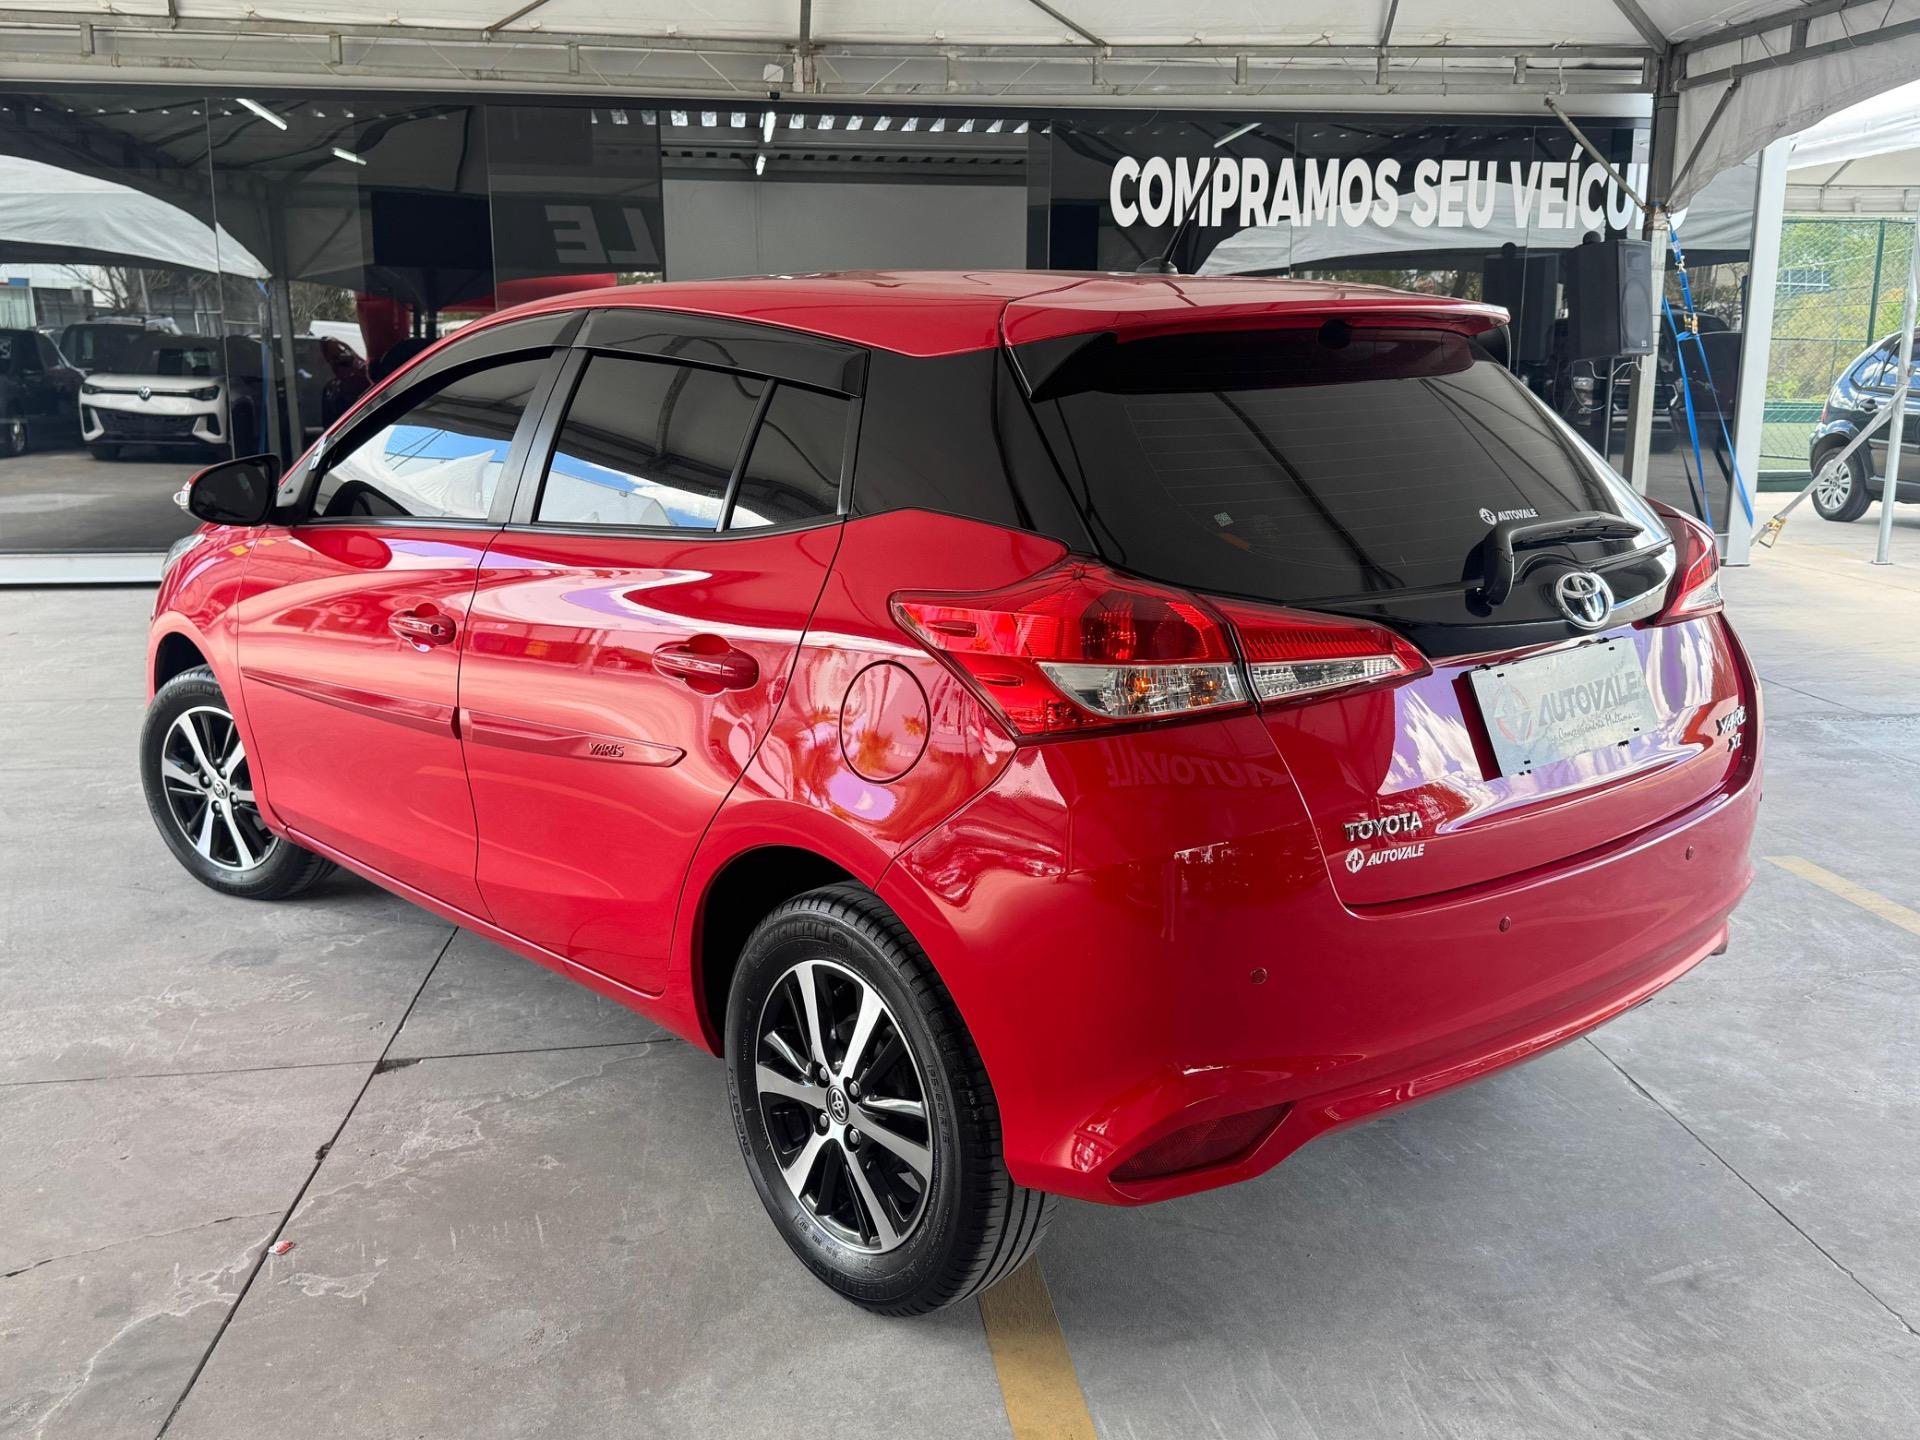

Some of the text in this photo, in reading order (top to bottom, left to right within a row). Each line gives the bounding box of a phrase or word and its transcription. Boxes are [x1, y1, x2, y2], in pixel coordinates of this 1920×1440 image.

[1109, 155, 1400, 228] COMPRAMOS
[1410, 158, 1498, 229] SEU
[1497, 508, 1539, 521] AUTOVALE
[1538, 672, 1641, 727] AUTOVALE
[588, 742, 625, 758] YARIS
[1343, 811, 1423, 842] TOYOTA
[1366, 843, 1425, 867] AUTOVALE
